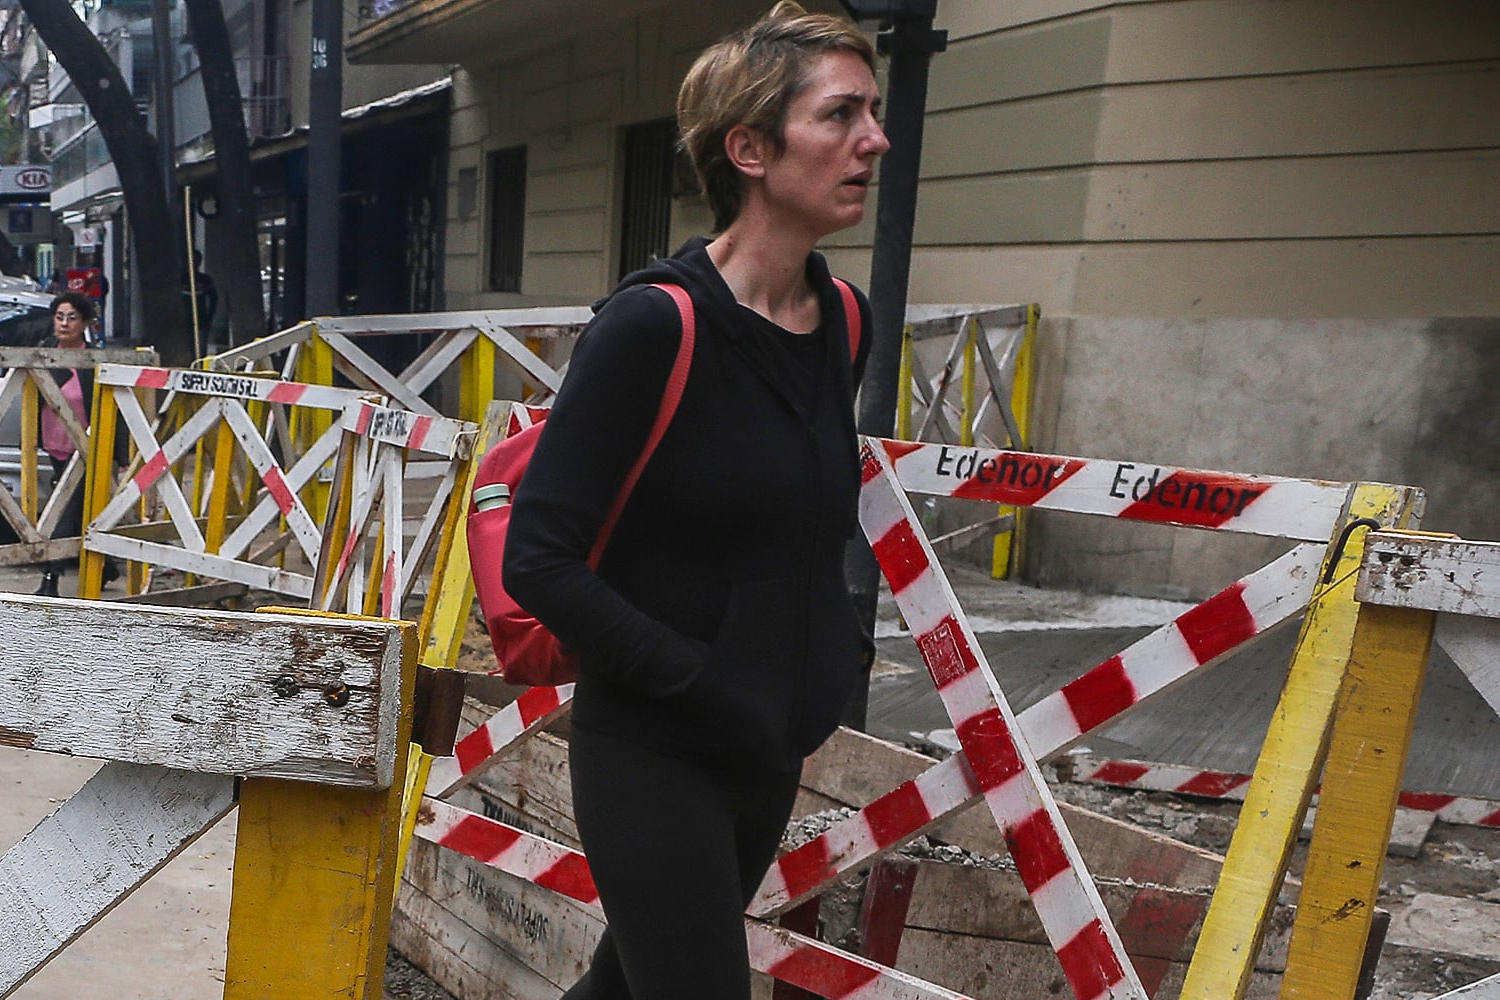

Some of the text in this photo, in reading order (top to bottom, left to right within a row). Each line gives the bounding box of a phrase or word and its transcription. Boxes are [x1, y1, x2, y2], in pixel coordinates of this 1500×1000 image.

[22, 174, 49, 186] KIA
[936, 446, 1064, 491] Edenor
[1108, 462, 1264, 518] Edenor
